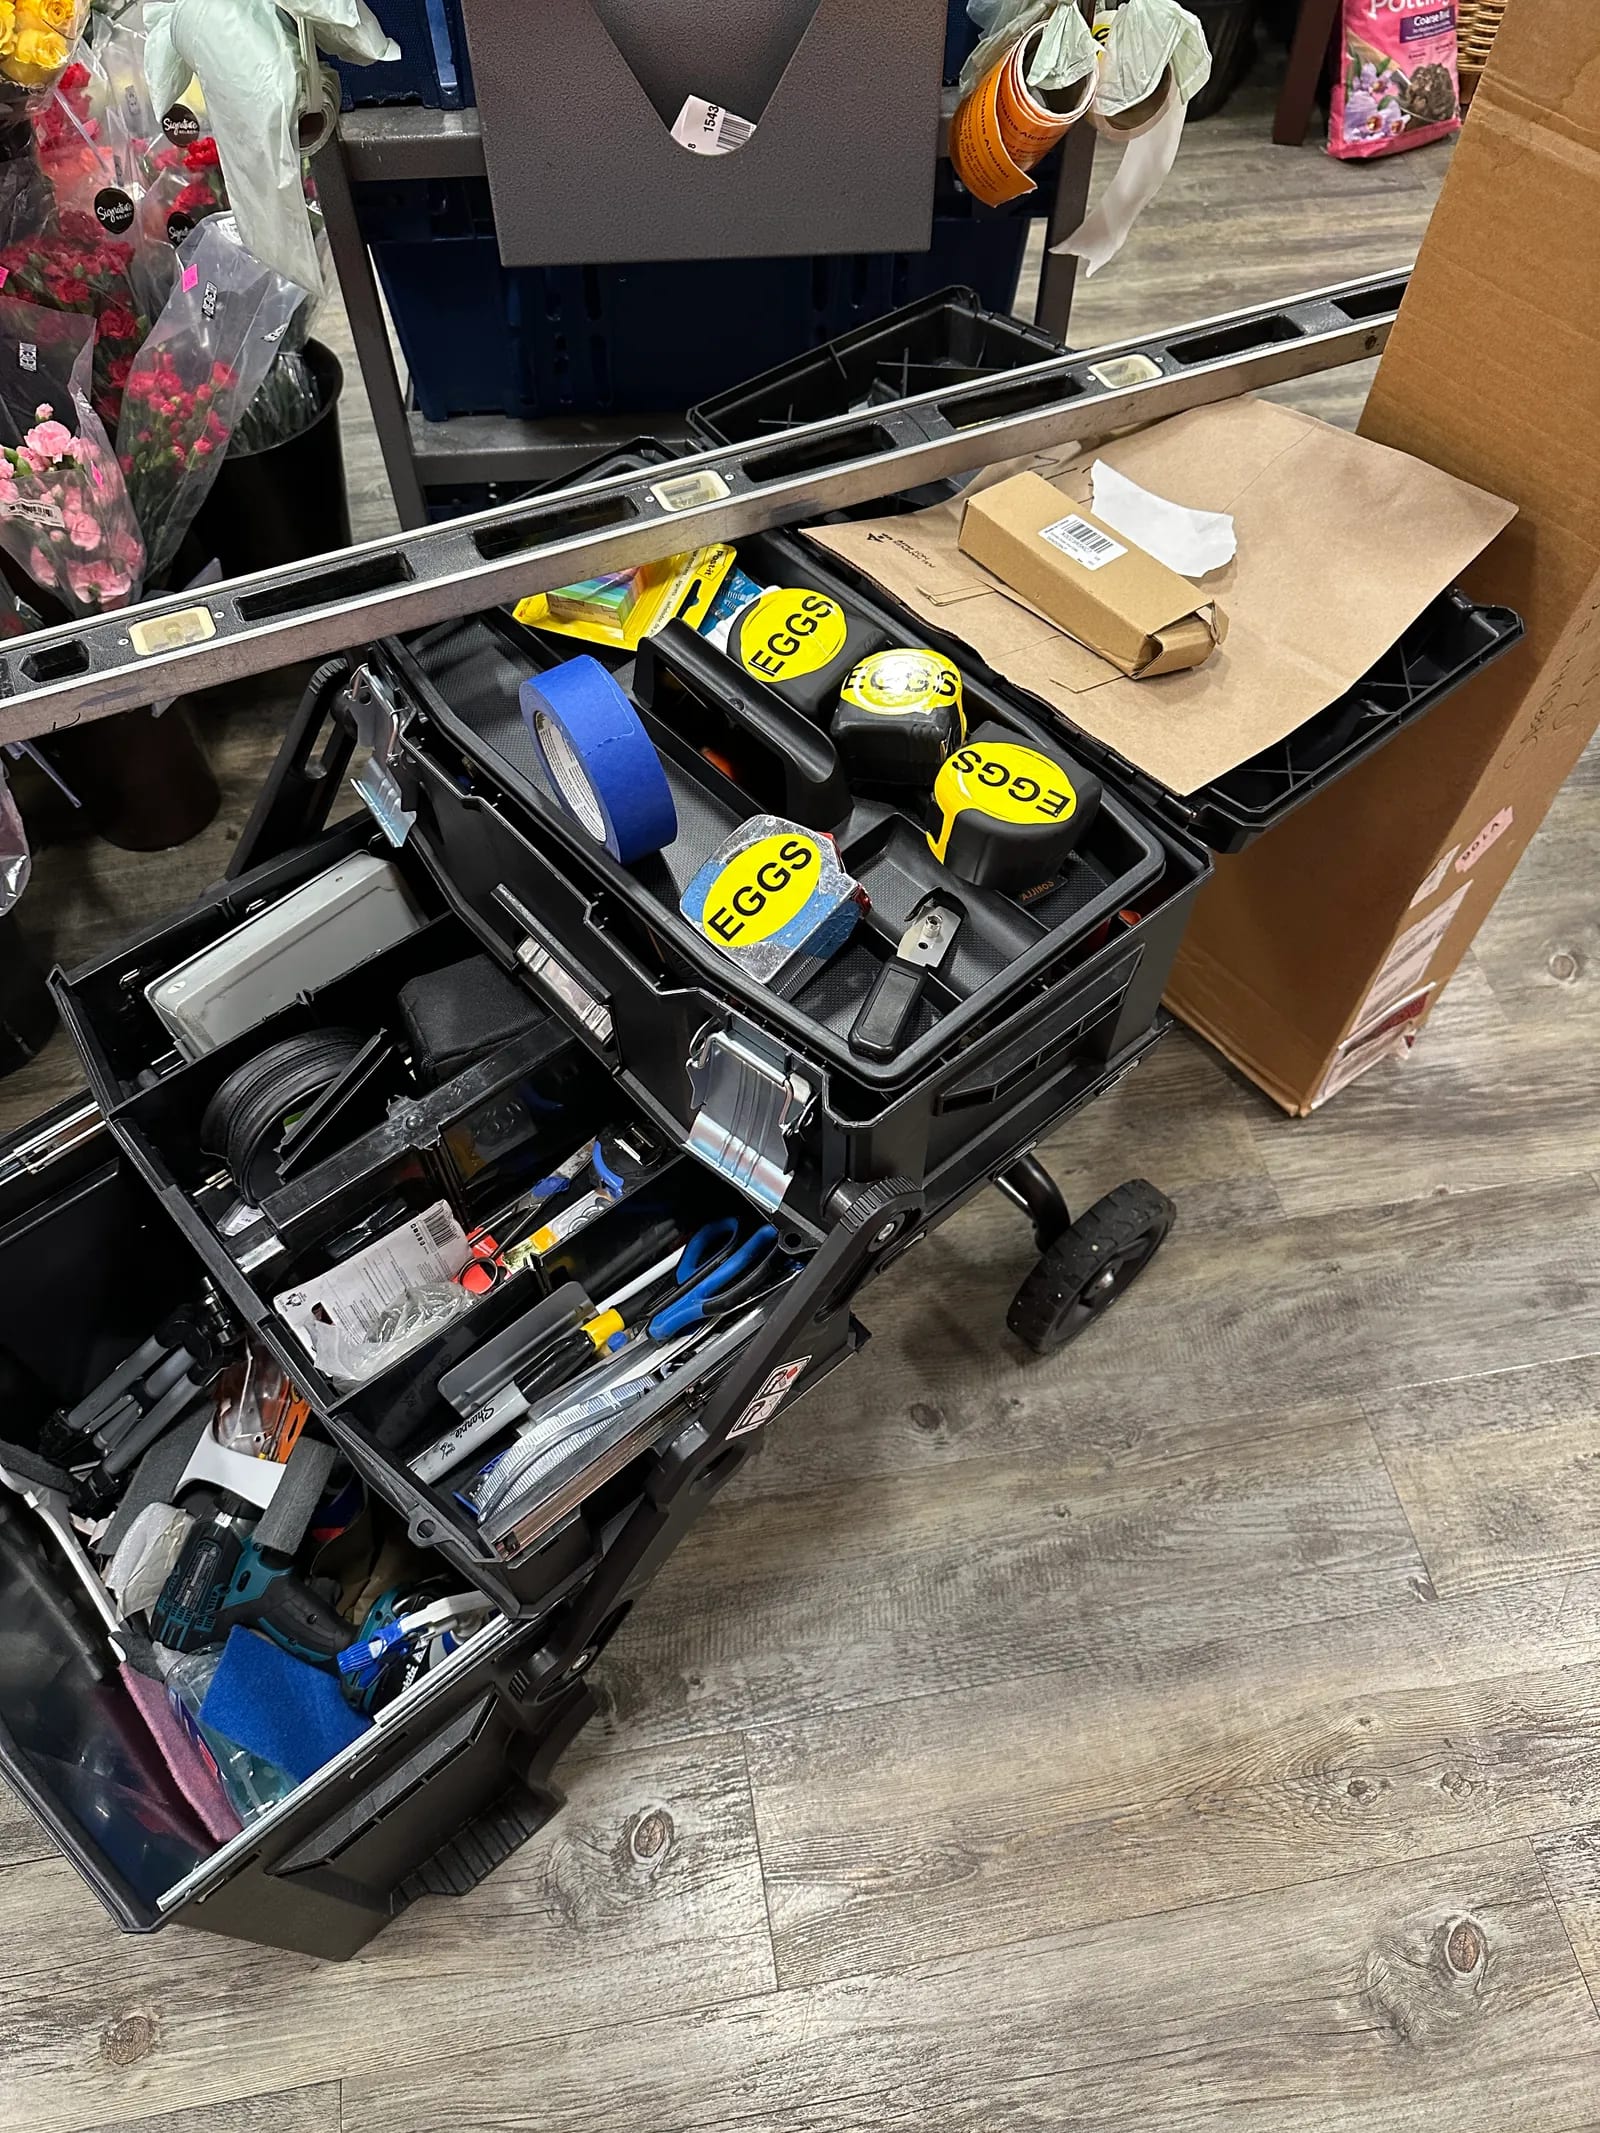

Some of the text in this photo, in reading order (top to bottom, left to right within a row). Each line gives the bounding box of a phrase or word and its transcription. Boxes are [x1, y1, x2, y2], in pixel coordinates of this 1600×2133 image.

[703, 105, 720, 133] 1543
[704, 549, 724, 577] Post-it
[748, 595, 834, 677] EGGS
[843, 666, 959, 697] EGGS
[951, 749, 1073, 818] EGGS
[707, 840, 813, 943] EGGS
[450, 1398, 496, 1438] Sharpie
